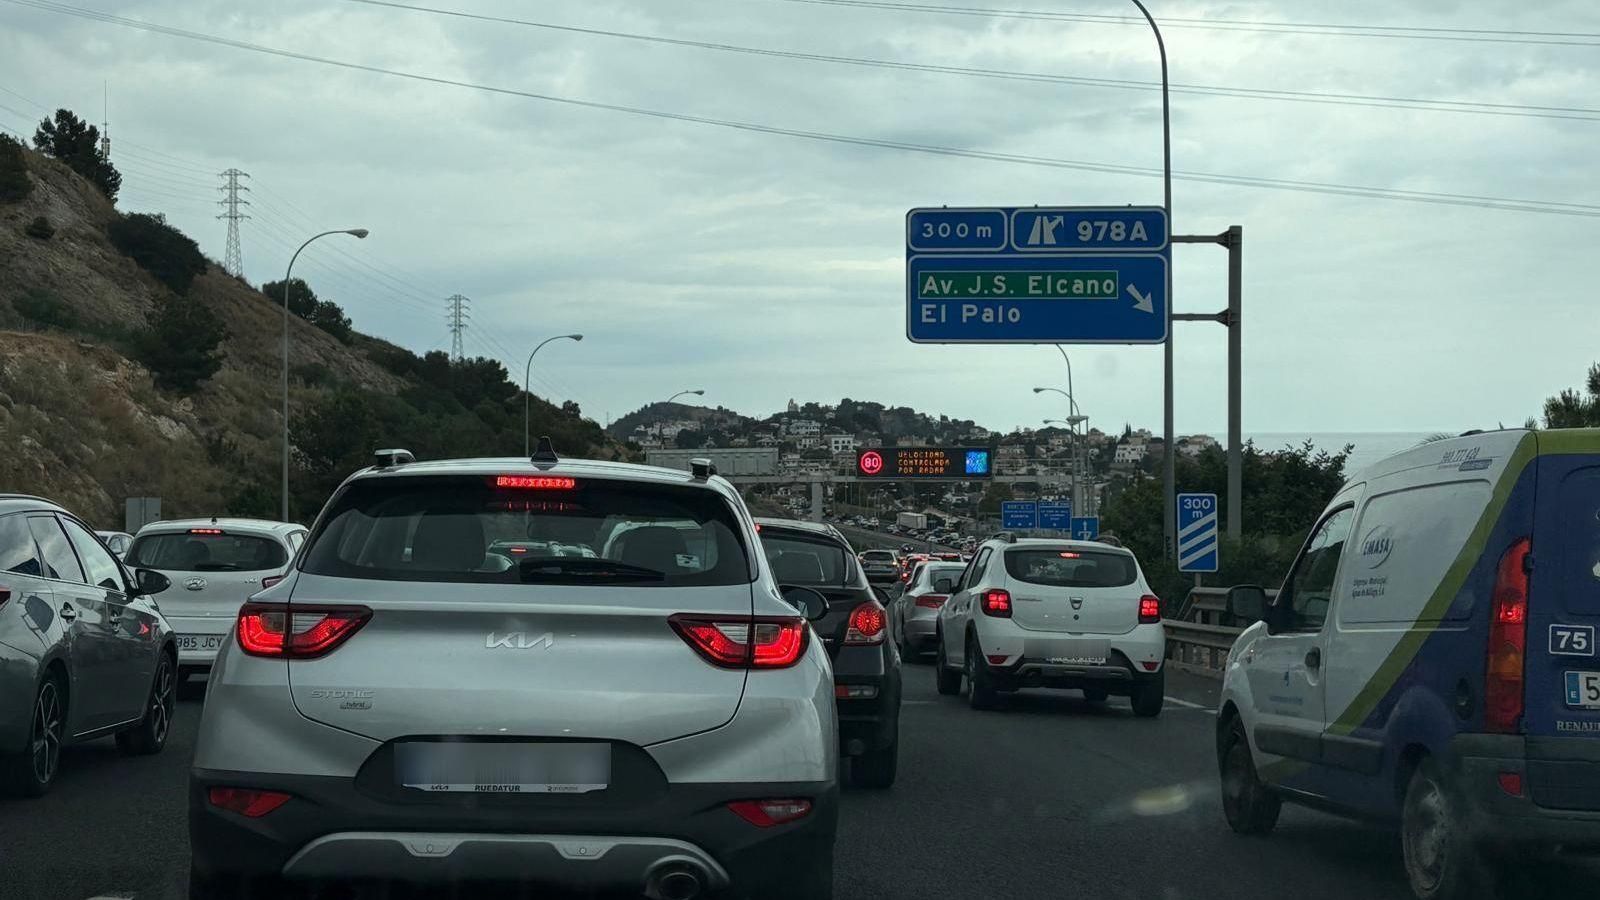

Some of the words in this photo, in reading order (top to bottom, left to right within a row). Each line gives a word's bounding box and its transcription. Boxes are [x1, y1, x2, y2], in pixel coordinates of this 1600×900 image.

[922, 223, 969, 238] 300
[976, 224, 992, 237] m
[1077, 221, 1148, 241] 978A
[922, 276, 958, 294] Av.
[968, 276, 1014, 294] J.S.
[1028, 276, 1115, 294] Elcano
[921, 304, 946, 323] El
[962, 304, 1021, 323] Palo
[864, 457, 878, 468] 80
[1183, 498, 1211, 509] 300
[1192, 510, 1203, 518] m
[486, 631, 554, 649] KIA
[1556, 631, 1588, 650] 75
[311, 689, 375, 699] STONIC
[1570, 690, 1577, 698] E
[474, 785, 521, 793] RUEDATUR
